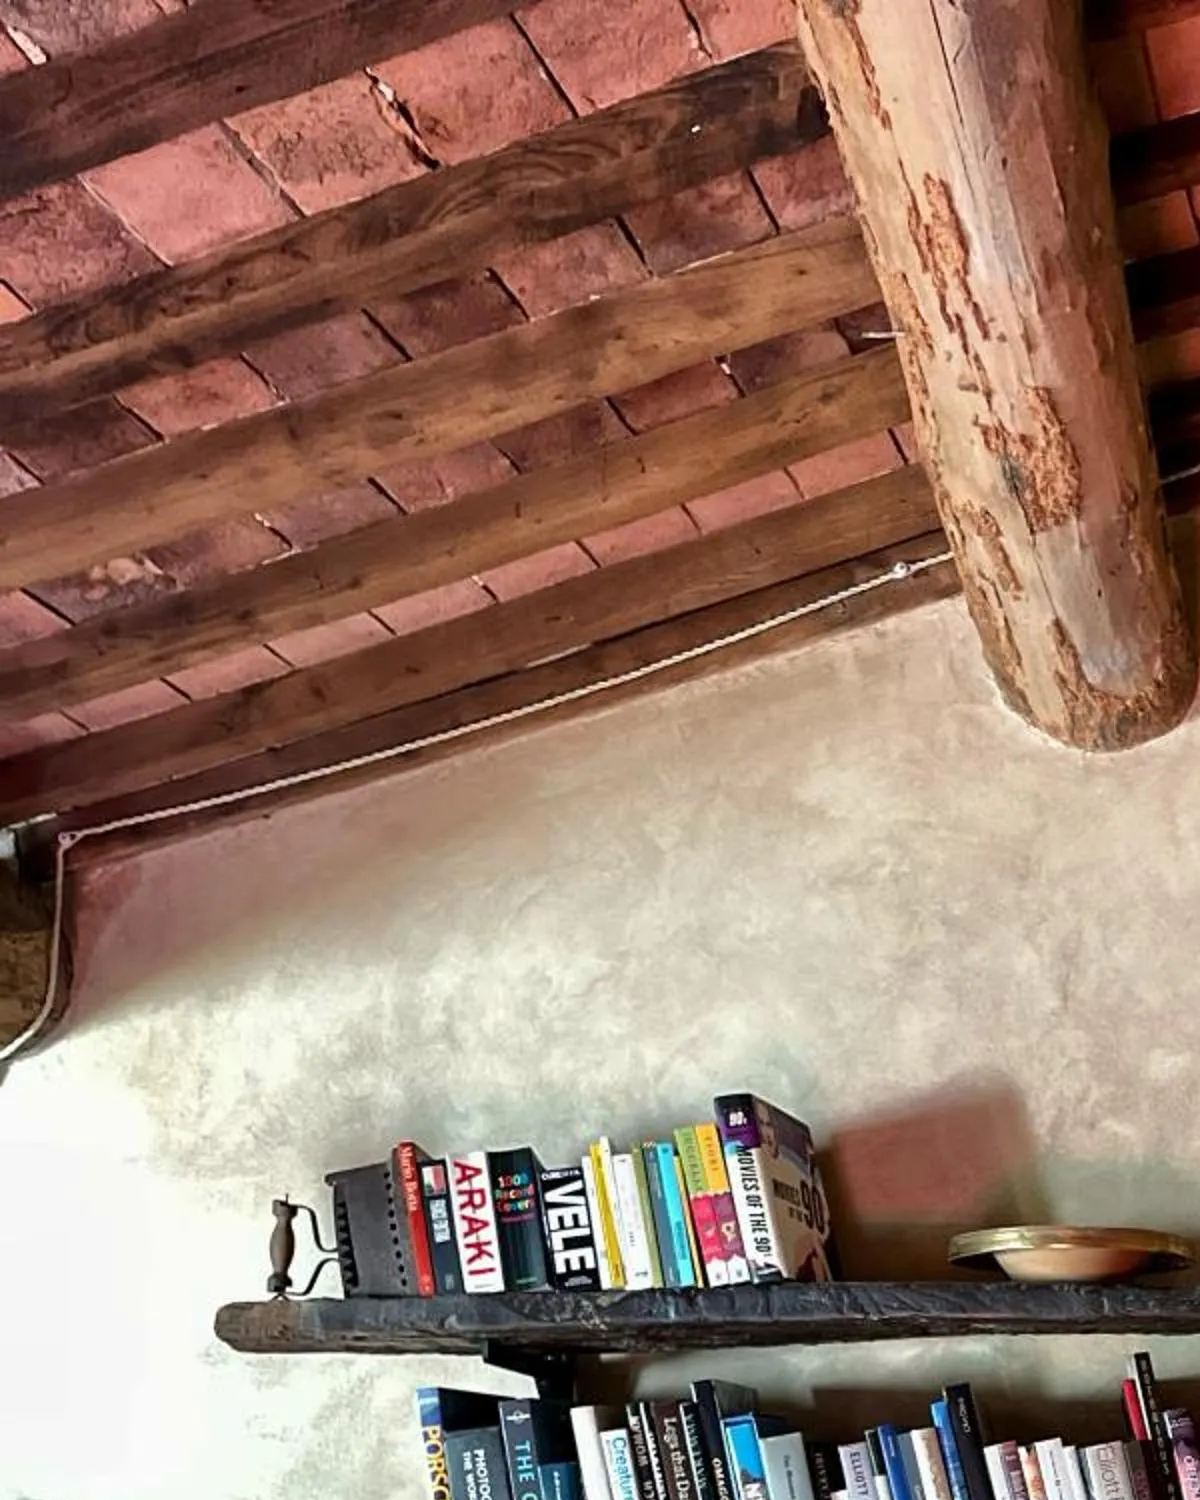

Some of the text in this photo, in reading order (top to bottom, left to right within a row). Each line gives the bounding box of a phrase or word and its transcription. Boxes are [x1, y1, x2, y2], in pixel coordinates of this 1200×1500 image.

[400, 1146, 421, 1212] Mario Botta
[734, 1143, 763, 1192] MOVIES
[451, 1156, 498, 1278] ARAKI
[744, 1193, 764, 1210] OF
[748, 1211, 770, 1236] THE
[542, 1180, 597, 1275] VELE
[628, 1414, 649, 1468] WOMAN
[659, 1415, 685, 1449] Legs
[461, 1451, 473, 1471] THE
[512, 1440, 536, 1483] THE
[669, 1450, 689, 1479] that
[848, 1450, 870, 1498] ELLIOTT
[1095, 1445, 1125, 1497] Elliott
